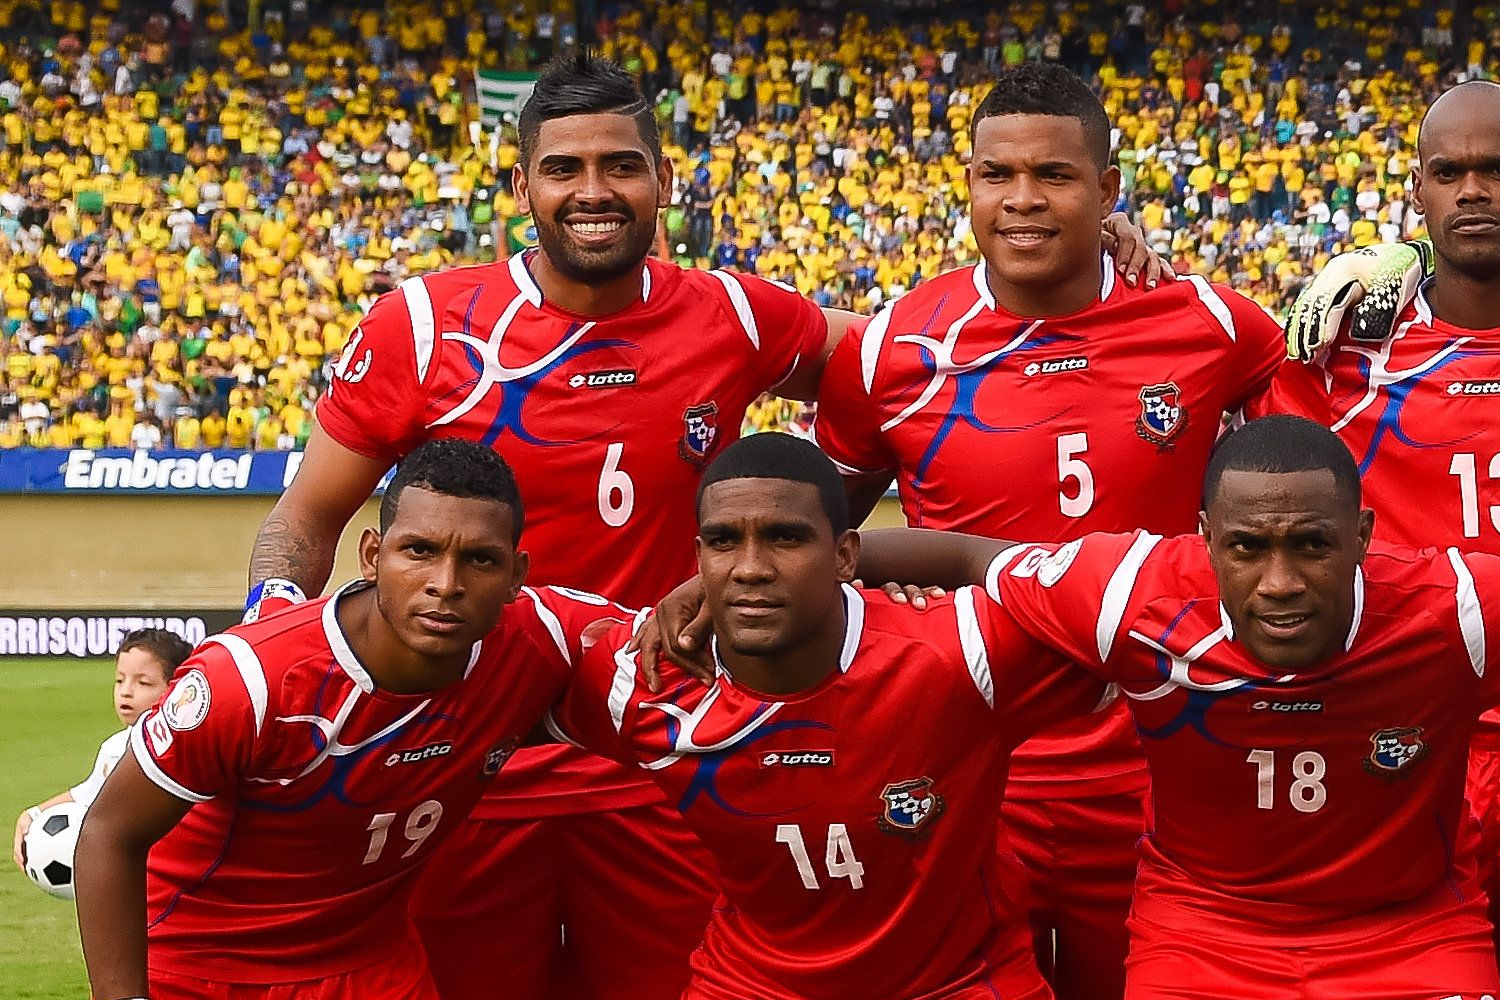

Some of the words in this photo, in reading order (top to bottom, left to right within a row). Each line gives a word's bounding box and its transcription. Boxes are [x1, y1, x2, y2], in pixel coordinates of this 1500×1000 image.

[64, 449, 253, 489] Embratel
[598, 442, 634, 527] 6
[1058, 432, 1094, 517] 5
[1246, 749, 1327, 813] 18
[362, 799, 443, 865] 19
[776, 823, 864, 890] 14
